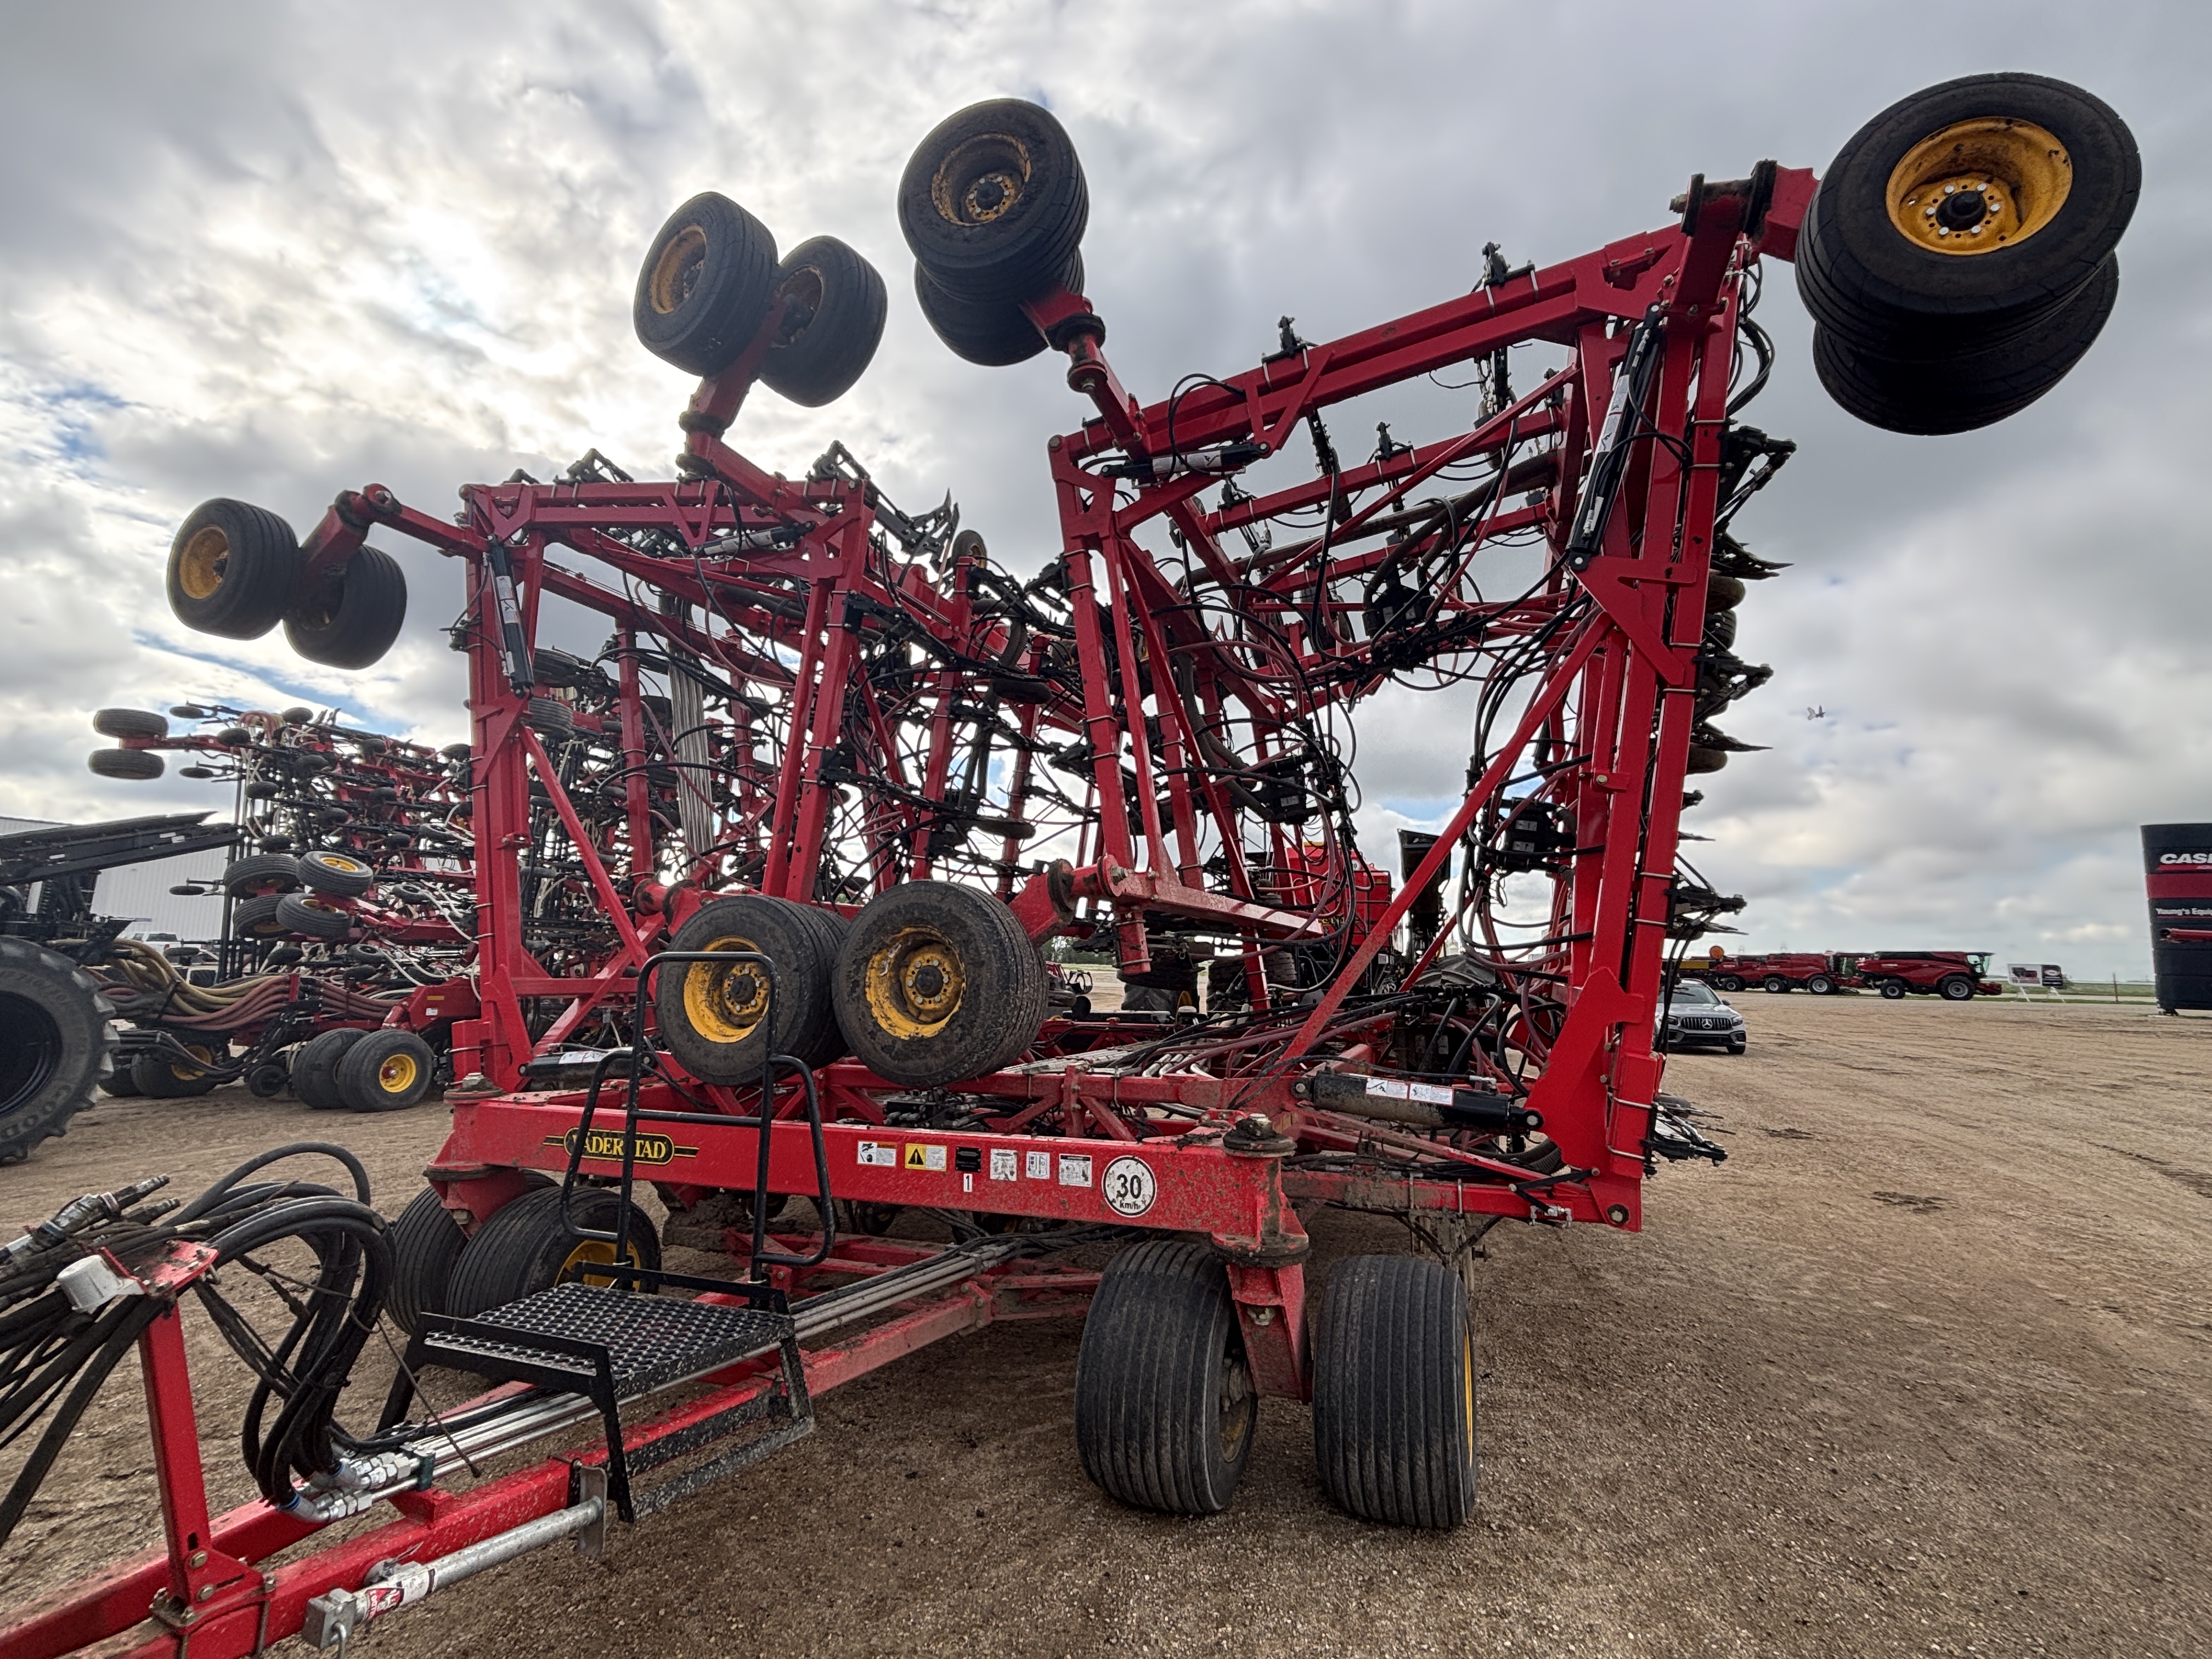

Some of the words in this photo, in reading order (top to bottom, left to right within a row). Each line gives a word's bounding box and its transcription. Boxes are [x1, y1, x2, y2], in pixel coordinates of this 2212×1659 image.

[966, 1175, 970, 1190] 1
[1116, 1173, 1142, 1199] 30
[1120, 1199, 1139, 1210] km/h
